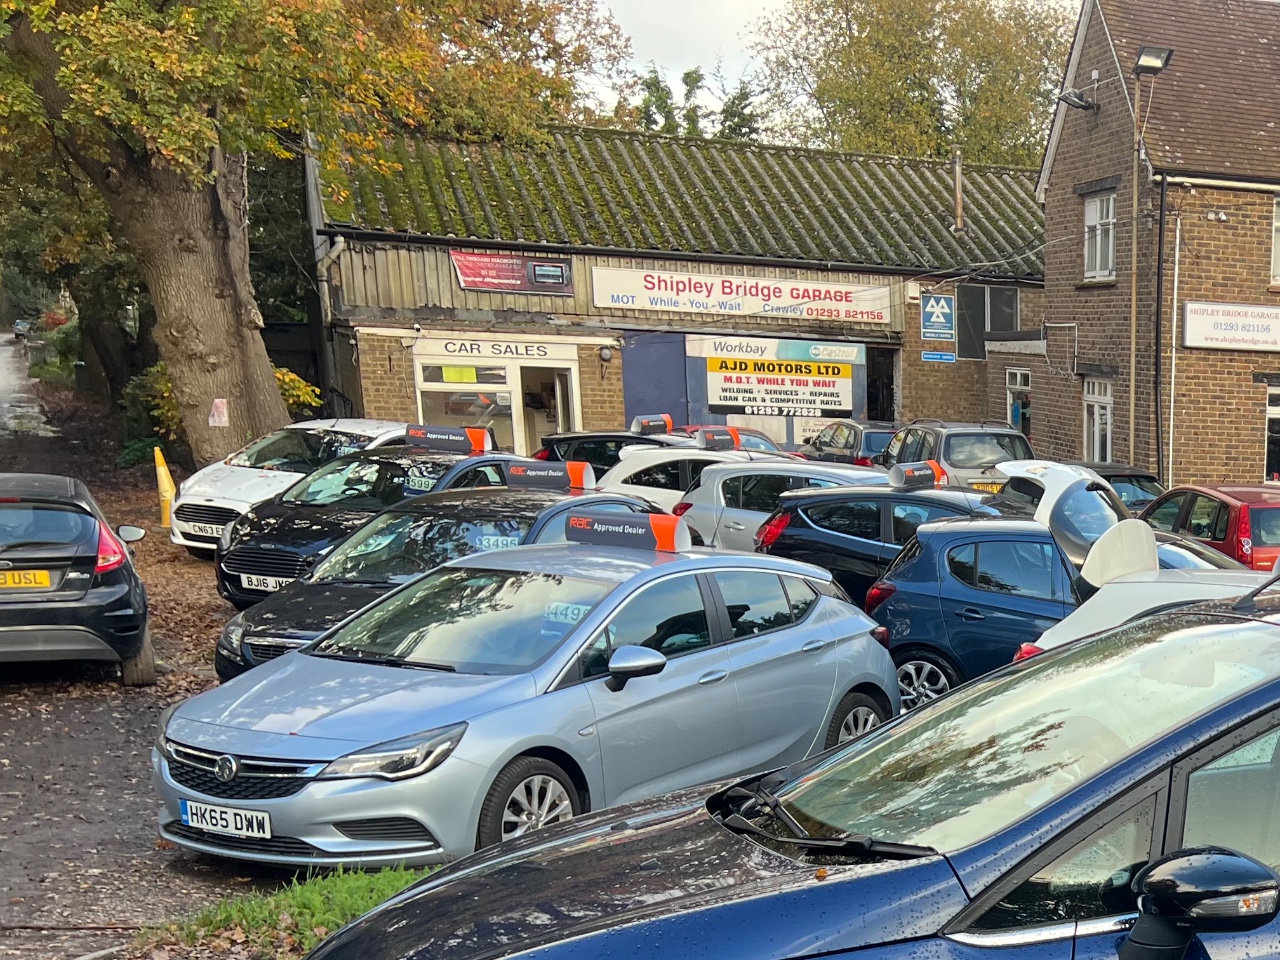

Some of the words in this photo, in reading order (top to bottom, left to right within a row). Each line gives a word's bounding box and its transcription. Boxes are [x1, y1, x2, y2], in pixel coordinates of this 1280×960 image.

[643, 274, 714, 297] Shipley
[721, 280, 783, 302] Bridge
[790, 287, 853, 303] GARAGE
[610, 294, 637, 305] MOT
[648, 297, 680, 308] While
[688, 299, 709, 310] You
[718, 301, 742, 311] Wait
[763, 303, 804, 316] Crawley
[806, 308, 841, 318] 01293
[844, 309, 884, 321] 821156
[1189, 308, 1221, 317] SHIPLEY
[1222, 309, 1249, 318] BRIDGE
[1250, 311, 1279, 320] GARAGE
[1213, 321, 1239, 331] 01293
[1241, 323, 1271, 333] 821156
[1204, 335, 1279, 346] www.shipleybridge.co.uk
[444, 341, 481, 354] CAR
[491, 343, 548, 357] SALES
[713, 341, 767, 356] Workbay
[821, 347, 855, 358] Castrol
[719, 360, 748, 371] AJD
[753, 362, 812, 374] MOTORS
[817, 365, 841, 376] LTD
[723, 375, 753, 385] M.O.T.
[756, 377, 786, 386] WHILE
[788, 378, 809, 387] YOU
[812, 379, 837, 388] WAIT
[721, 387, 754, 395] WELDING
[764, 389, 799, 397] SERVICES
[770, 397, 817, 406] COMPETITIVE
[745, 405, 779, 415] 01293
[782, 407, 822, 417] 772828
[193, 525, 214, 534] CN63
[593, 522, 624, 532] Approved
[624, 526, 646, 535] Dealer
[12, 572, 43, 585] USL
[246, 576, 269, 588] BJ16
[189, 804, 229, 829] HK65
[233, 812, 266, 834] DWW
